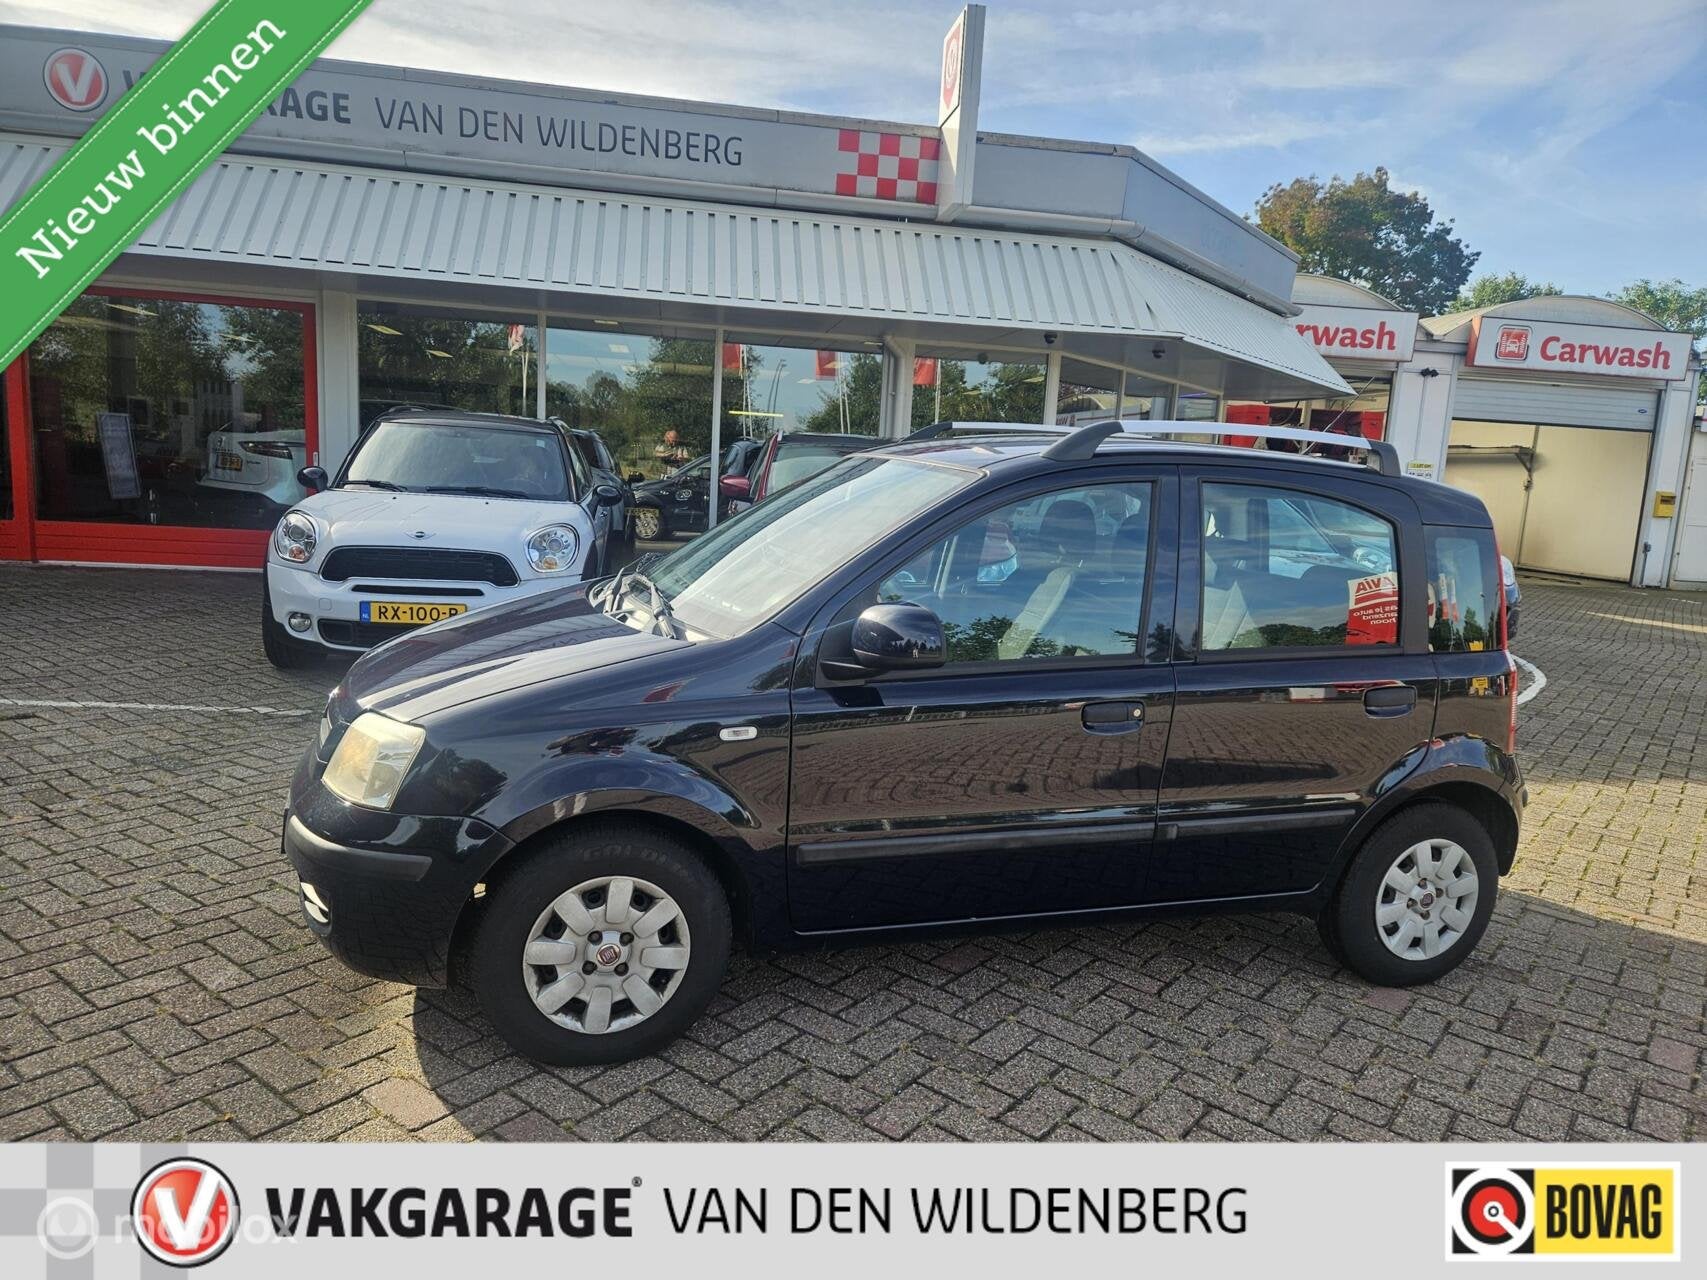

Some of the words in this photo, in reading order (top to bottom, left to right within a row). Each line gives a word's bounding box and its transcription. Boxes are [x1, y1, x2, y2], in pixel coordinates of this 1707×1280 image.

[374, 97, 443, 135] VAN
[459, 106, 523, 144] DEN
[536, 115, 742, 166] WILDENBERG
[1540, 336, 1671, 370] Carwash
